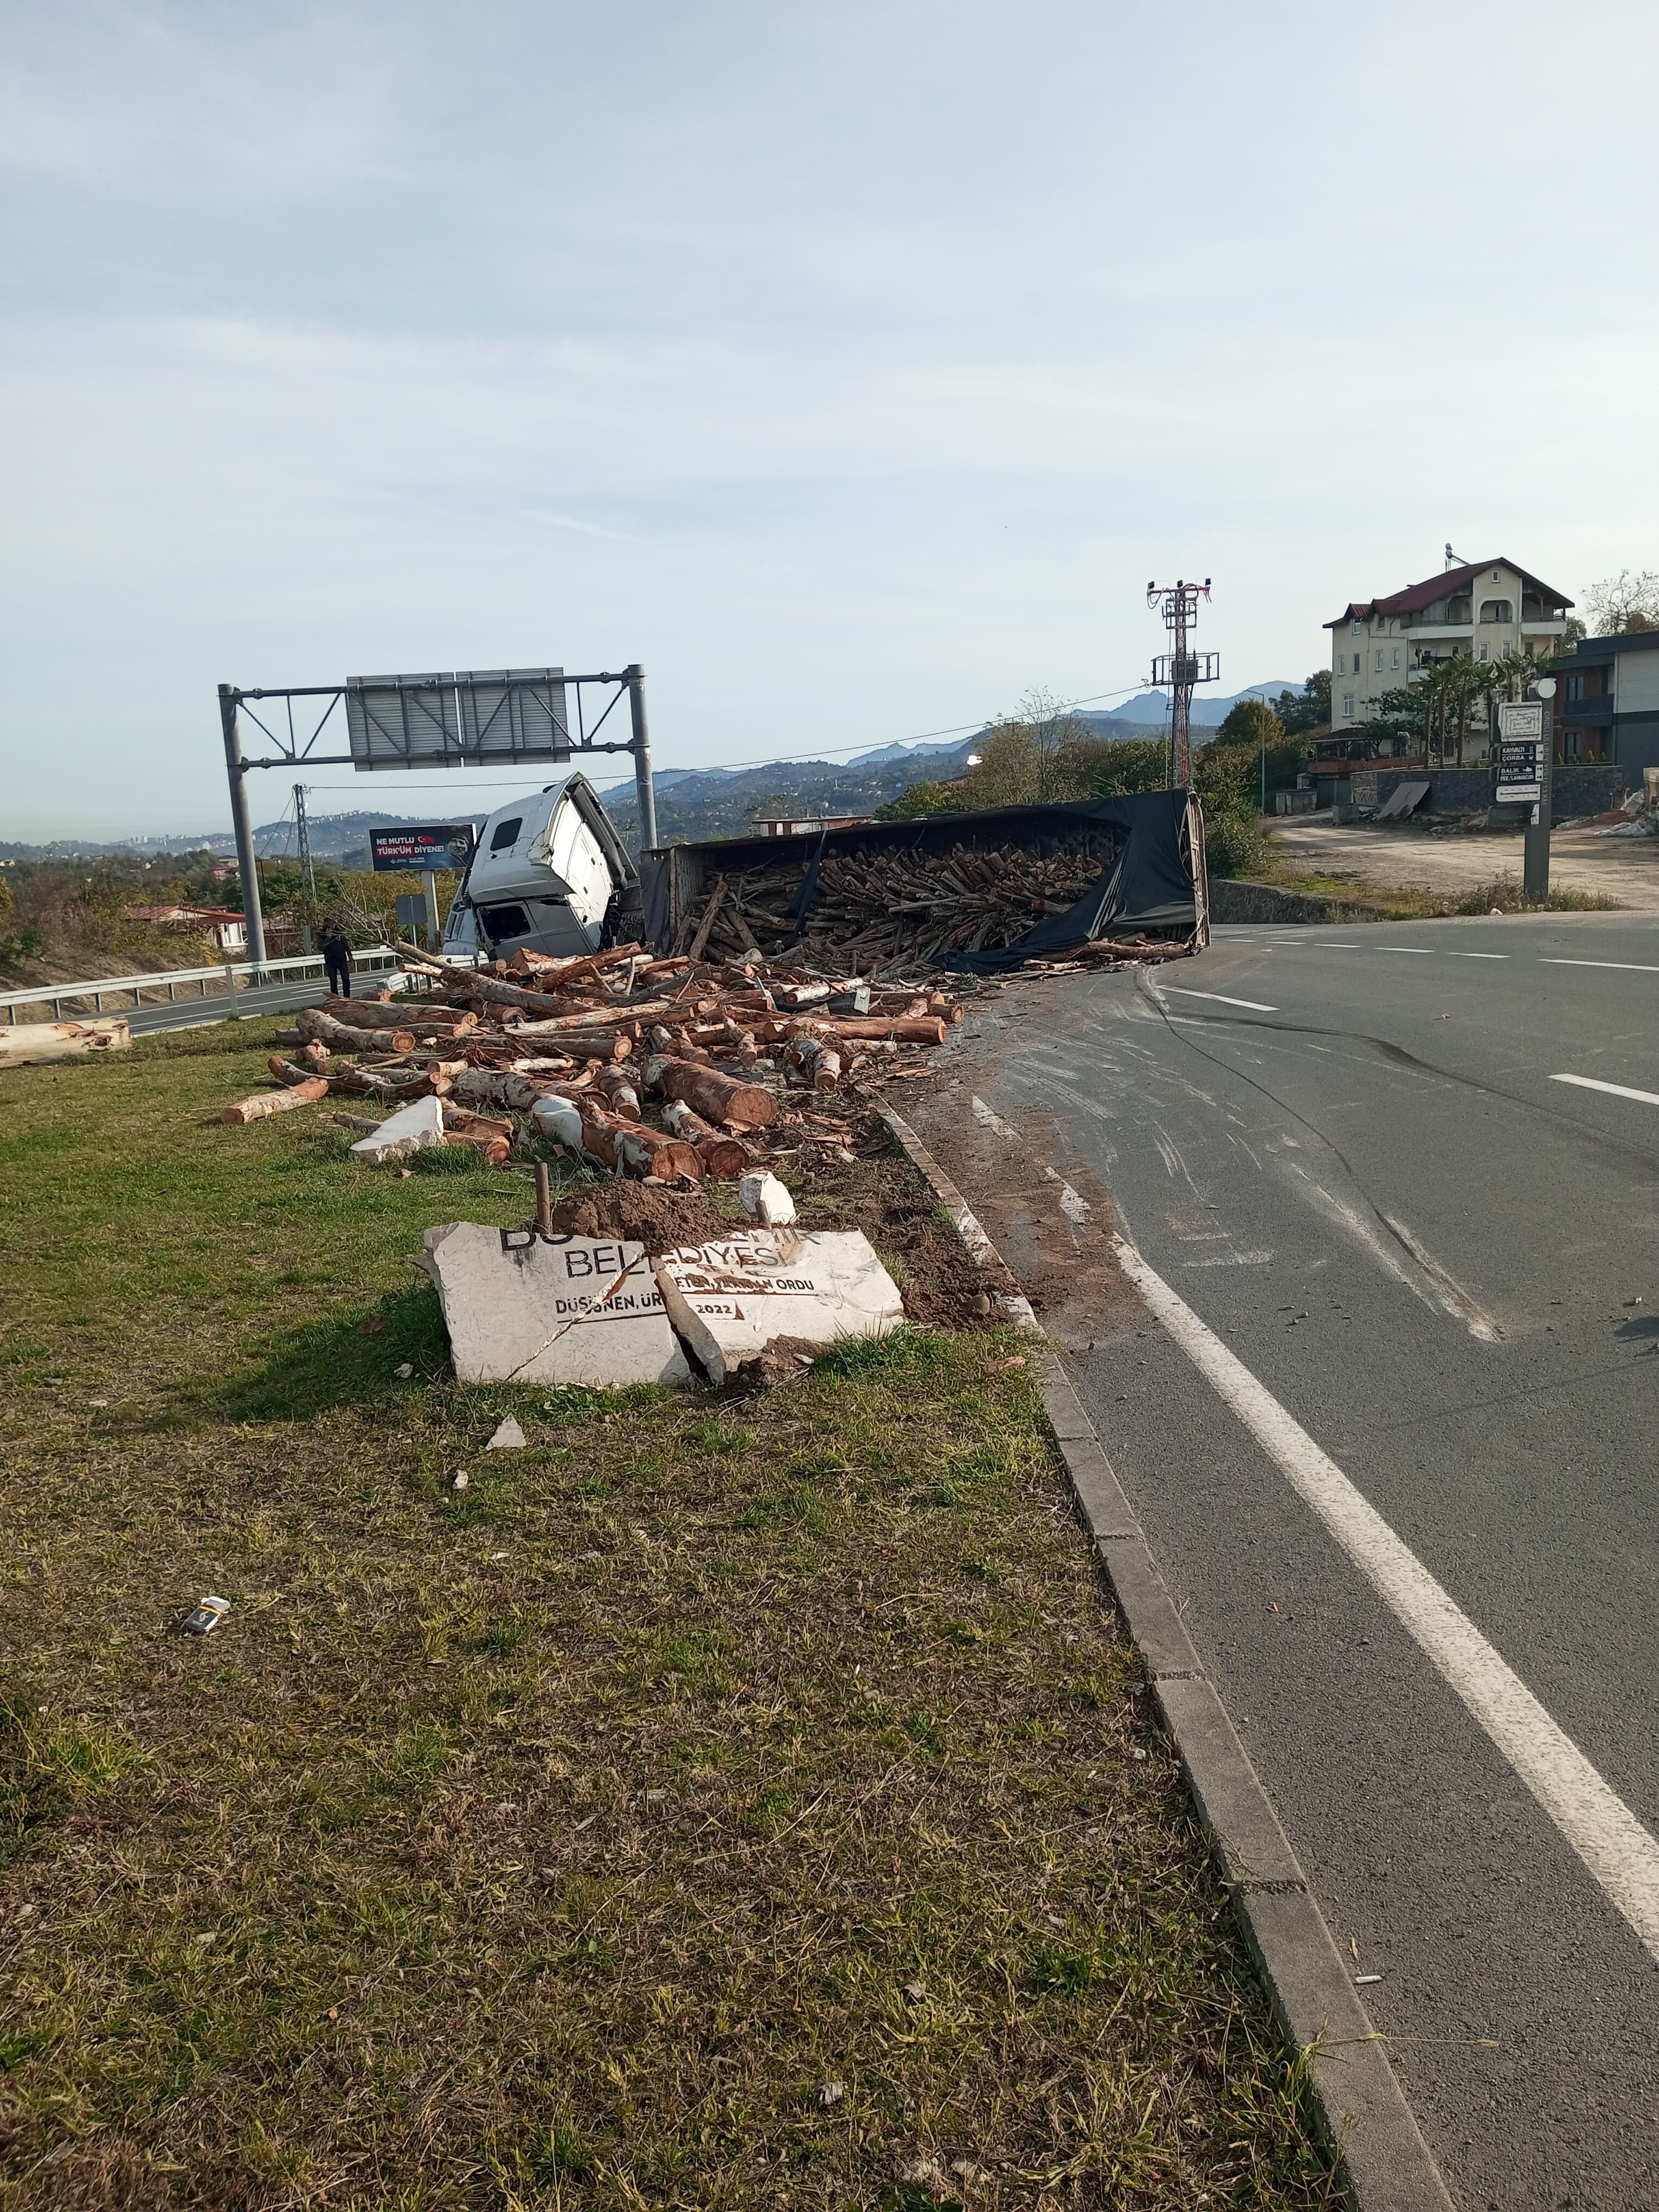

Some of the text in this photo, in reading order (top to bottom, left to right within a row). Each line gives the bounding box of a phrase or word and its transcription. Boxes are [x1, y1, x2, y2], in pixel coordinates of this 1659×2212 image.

[414, 845, 444, 854] DİYENE!
[775, 1279, 814, 1290] ORDU
[695, 1304, 732, 1314] 2022
